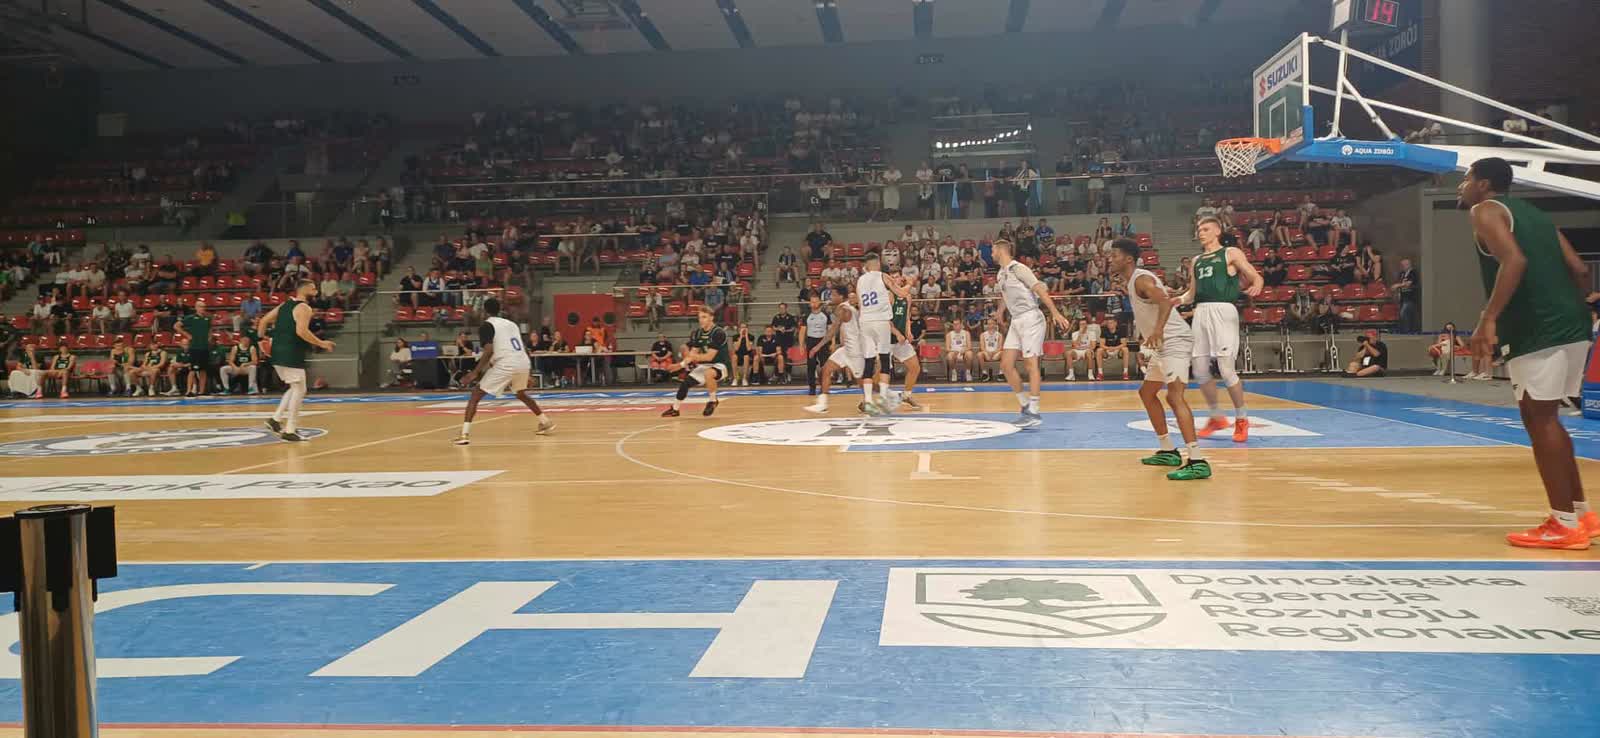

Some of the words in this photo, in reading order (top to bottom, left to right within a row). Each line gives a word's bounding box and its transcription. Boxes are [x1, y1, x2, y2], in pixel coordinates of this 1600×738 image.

[1267, 55, 1298, 89] SUZUKI
[1354, 147, 1372, 155] AQUA
[1198, 266, 1214, 280] 13
[861, 291, 879, 307] 22
[510, 337, 522, 352] 0
[32, 479, 217, 494] Bank
[226, 477, 454, 491] Pekao
[1168, 573, 1528, 590] Dolnośląska
[1189, 588, 1441, 605] Agencja
[1199, 605, 1482, 624] Rozwoju
[1216, 622, 1600, 643] Regionalne
